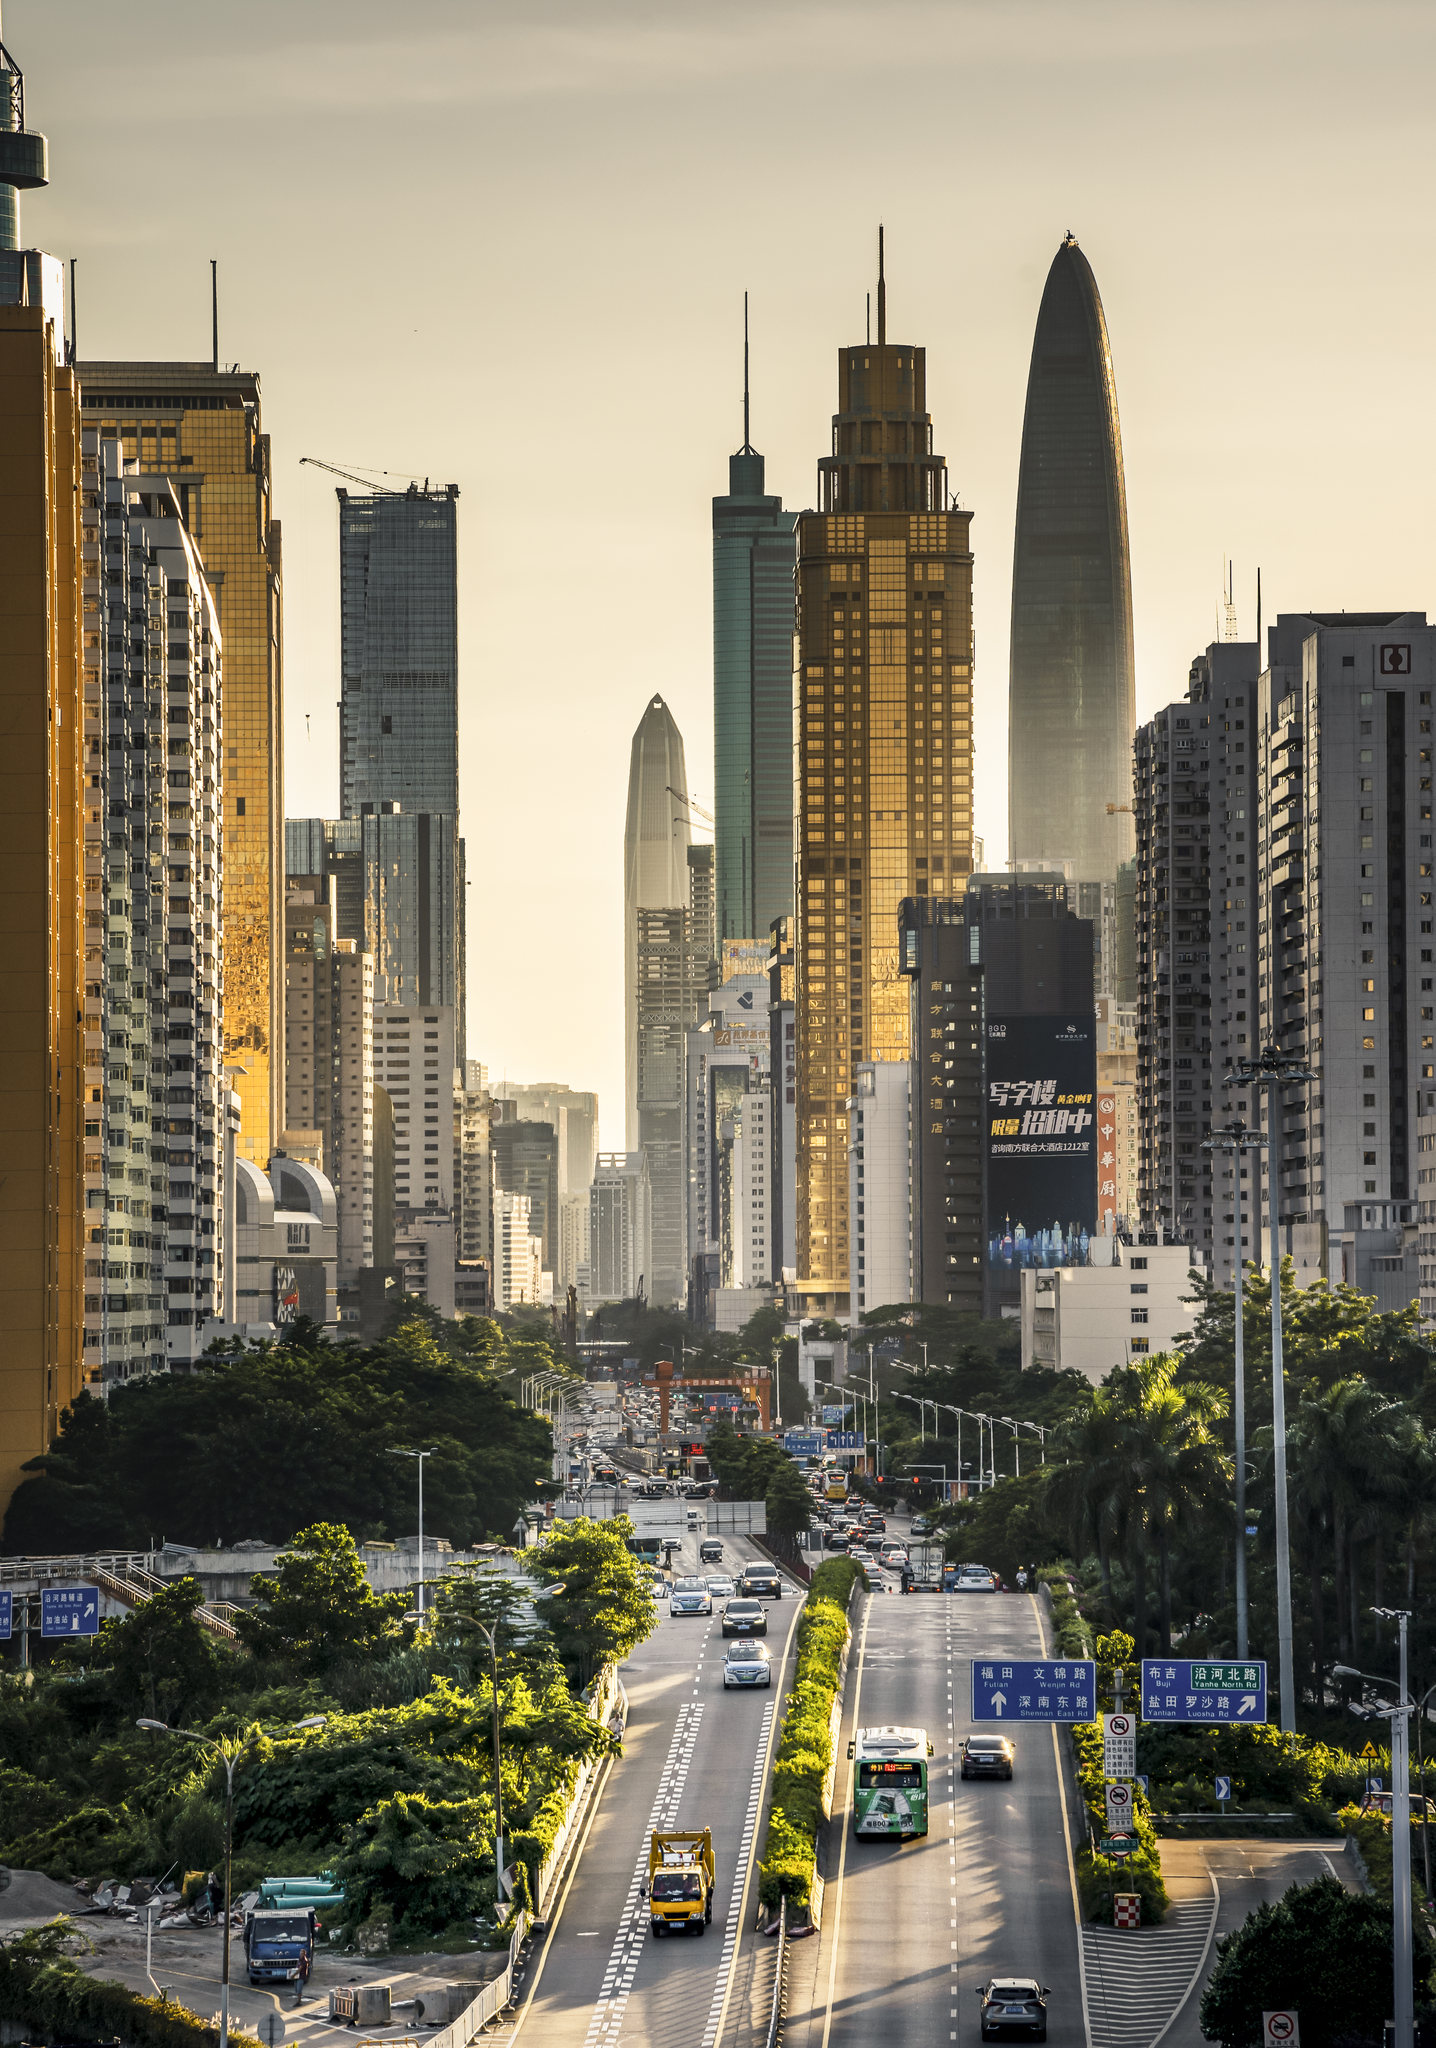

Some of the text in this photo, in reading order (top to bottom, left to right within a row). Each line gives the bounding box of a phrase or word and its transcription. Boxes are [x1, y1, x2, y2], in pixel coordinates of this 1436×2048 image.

[929, 981, 943, 1134] 南方联合大酒店
[989, 1080, 1057, 1106] 写字楼
[991, 1108, 1093, 1136] 限量 招租中
[1100, 1123, 1116, 1222] 中華厨
[46, 1614, 68, 1624] 加油站
[981, 1667, 1087, 1680] 福田 文锦路
[1149, 1667, 1176, 1679] 布吉
[1195, 1667, 1257, 1680] 沿河北路
[1039, 1681, 1066, 1689] Wenjin
[1156, 1680, 1171, 1688] Buji
[1018, 1695, 1088, 1708] 深南东路
[1148, 1695, 1229, 1709] 盐田 罗沙路
[1020, 1709, 1088, 1717] Shennan East Rd
